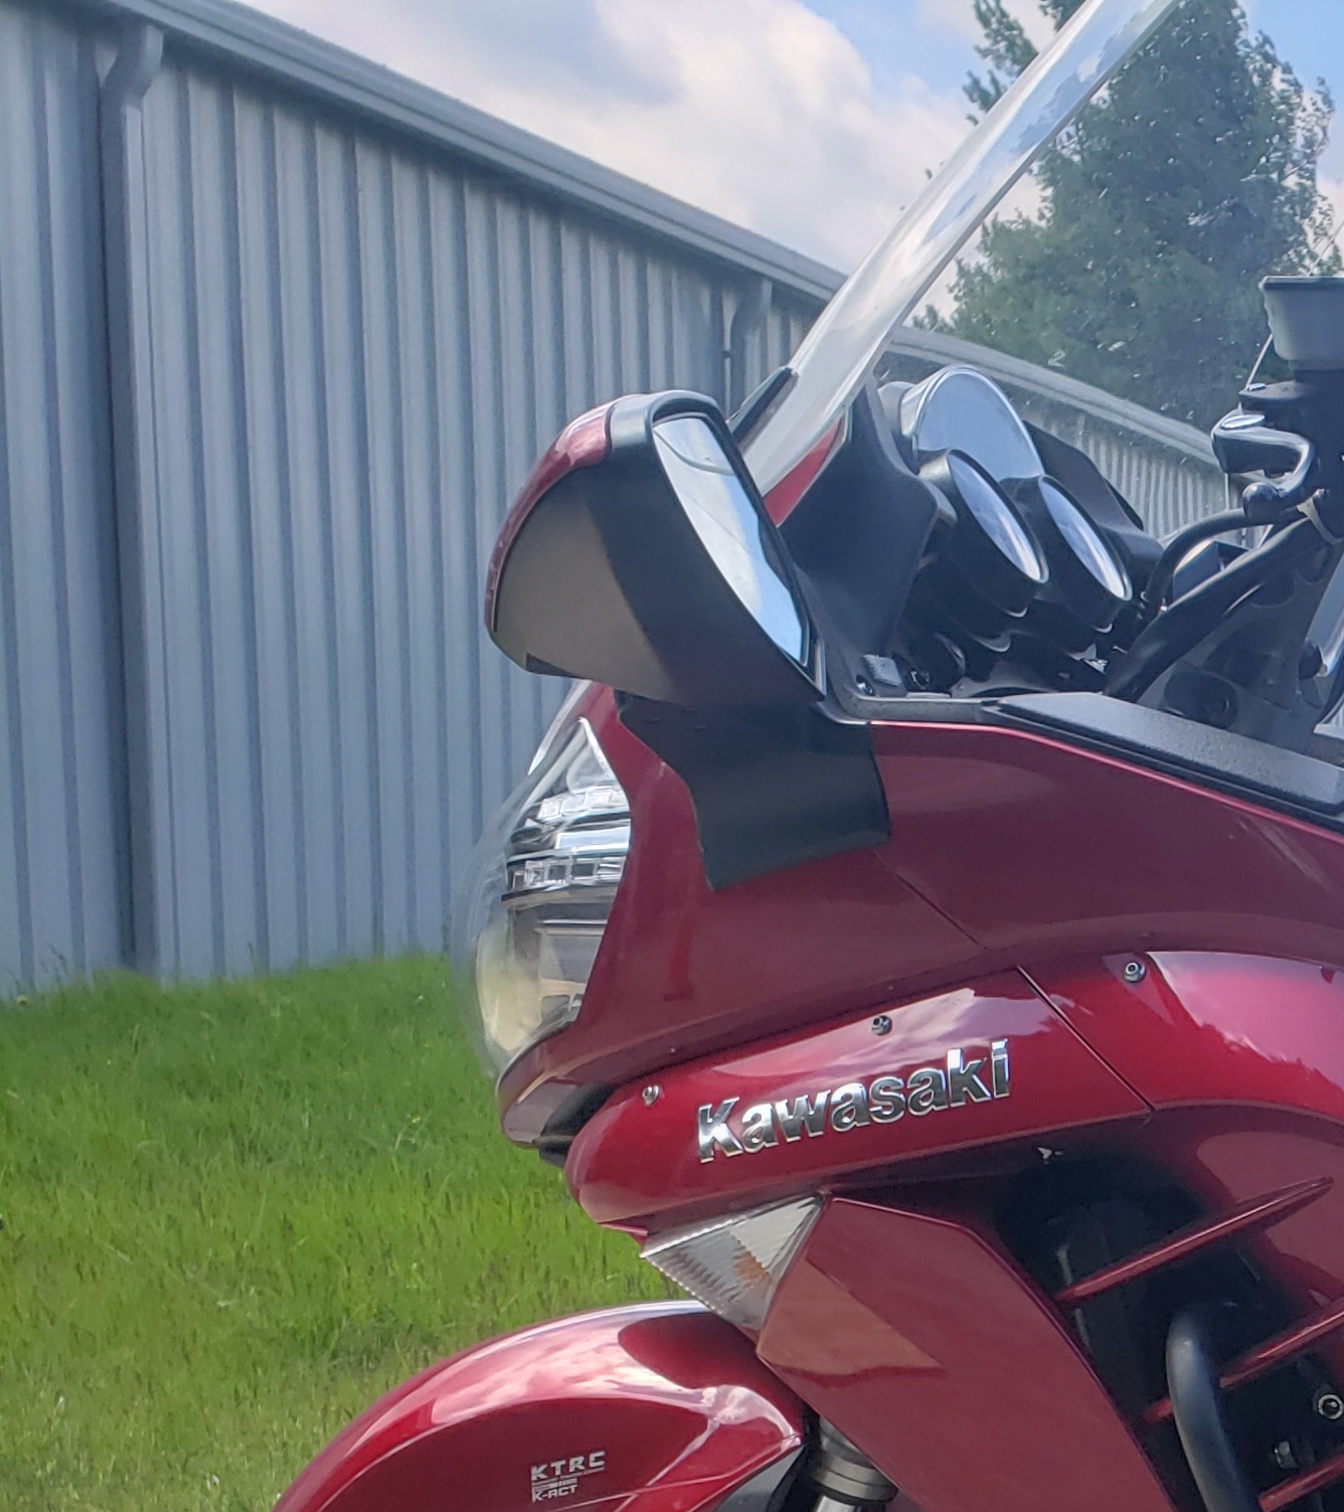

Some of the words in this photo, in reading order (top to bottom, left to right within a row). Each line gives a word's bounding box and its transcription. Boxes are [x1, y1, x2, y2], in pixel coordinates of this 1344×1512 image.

[697, 1039, 1010, 1163] Kawasaki
[531, 1451, 605, 1480] KTRC
[532, 1485, 578, 1502] K-ACT
